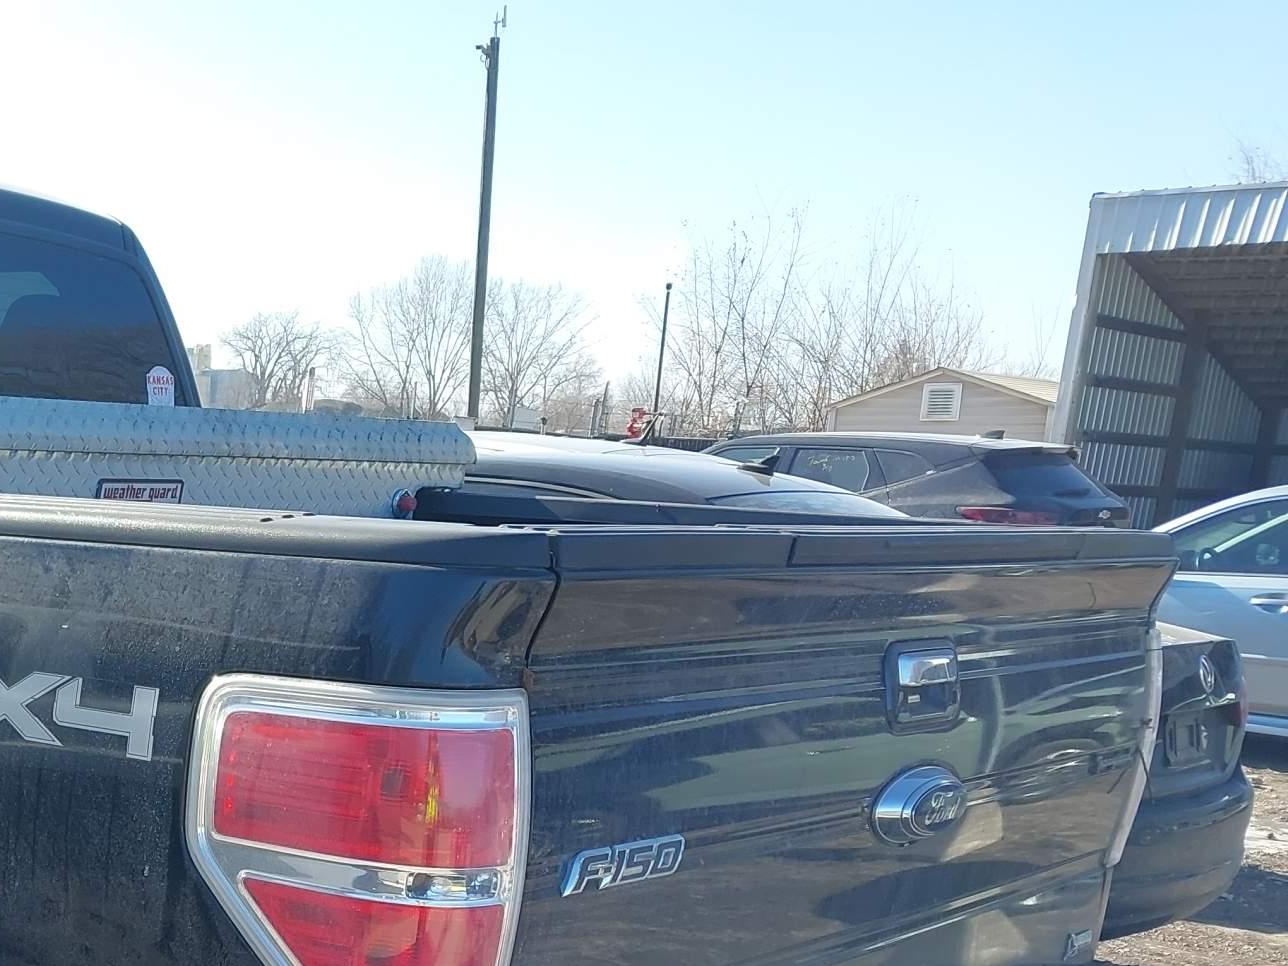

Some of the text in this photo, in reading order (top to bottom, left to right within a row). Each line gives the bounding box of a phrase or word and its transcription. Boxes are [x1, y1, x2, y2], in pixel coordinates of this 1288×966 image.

[147, 375, 174, 385] KANSAS
[152, 386, 168, 397] CITY
[103, 485, 178, 502] weather guard
[924, 791, 961, 825] Ford
